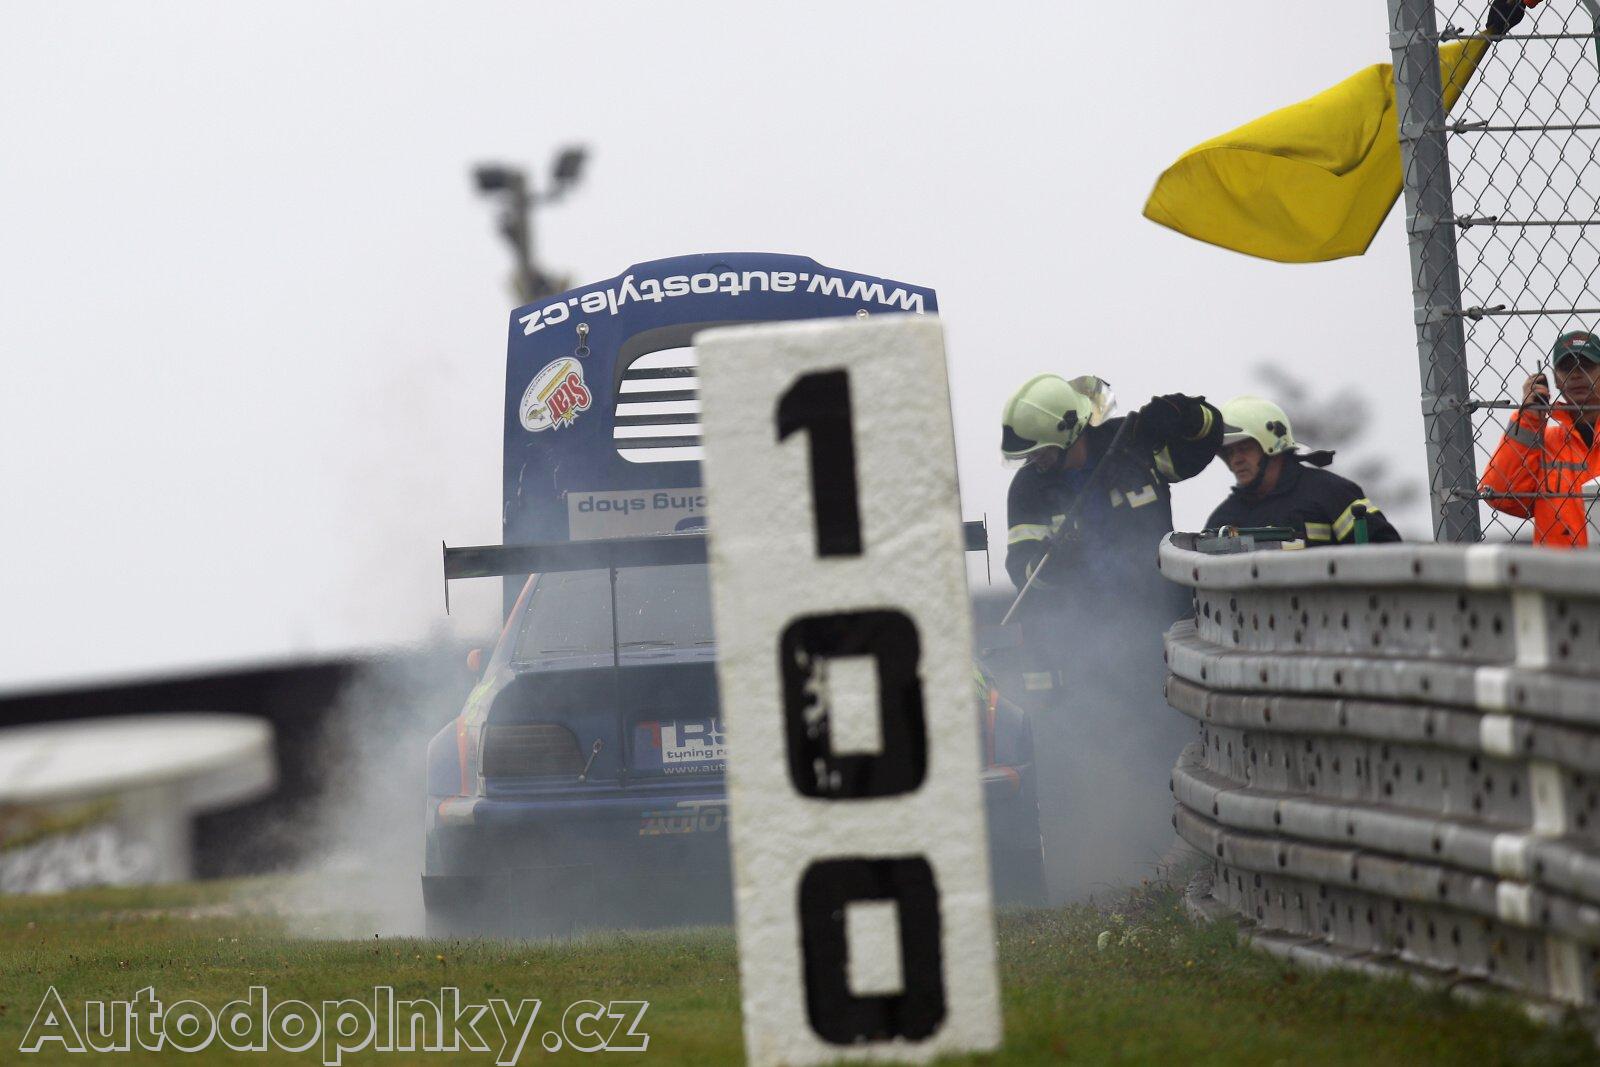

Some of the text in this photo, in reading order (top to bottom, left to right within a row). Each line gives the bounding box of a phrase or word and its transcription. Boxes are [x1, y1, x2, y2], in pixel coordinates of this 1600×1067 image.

[518, 269, 925, 336] www.autostyle.cz
[547, 372, 591, 424] Star
[578, 496, 645, 515] shop
[775, 366, 948, 1046] 100
[666, 748, 713, 760] tuning
